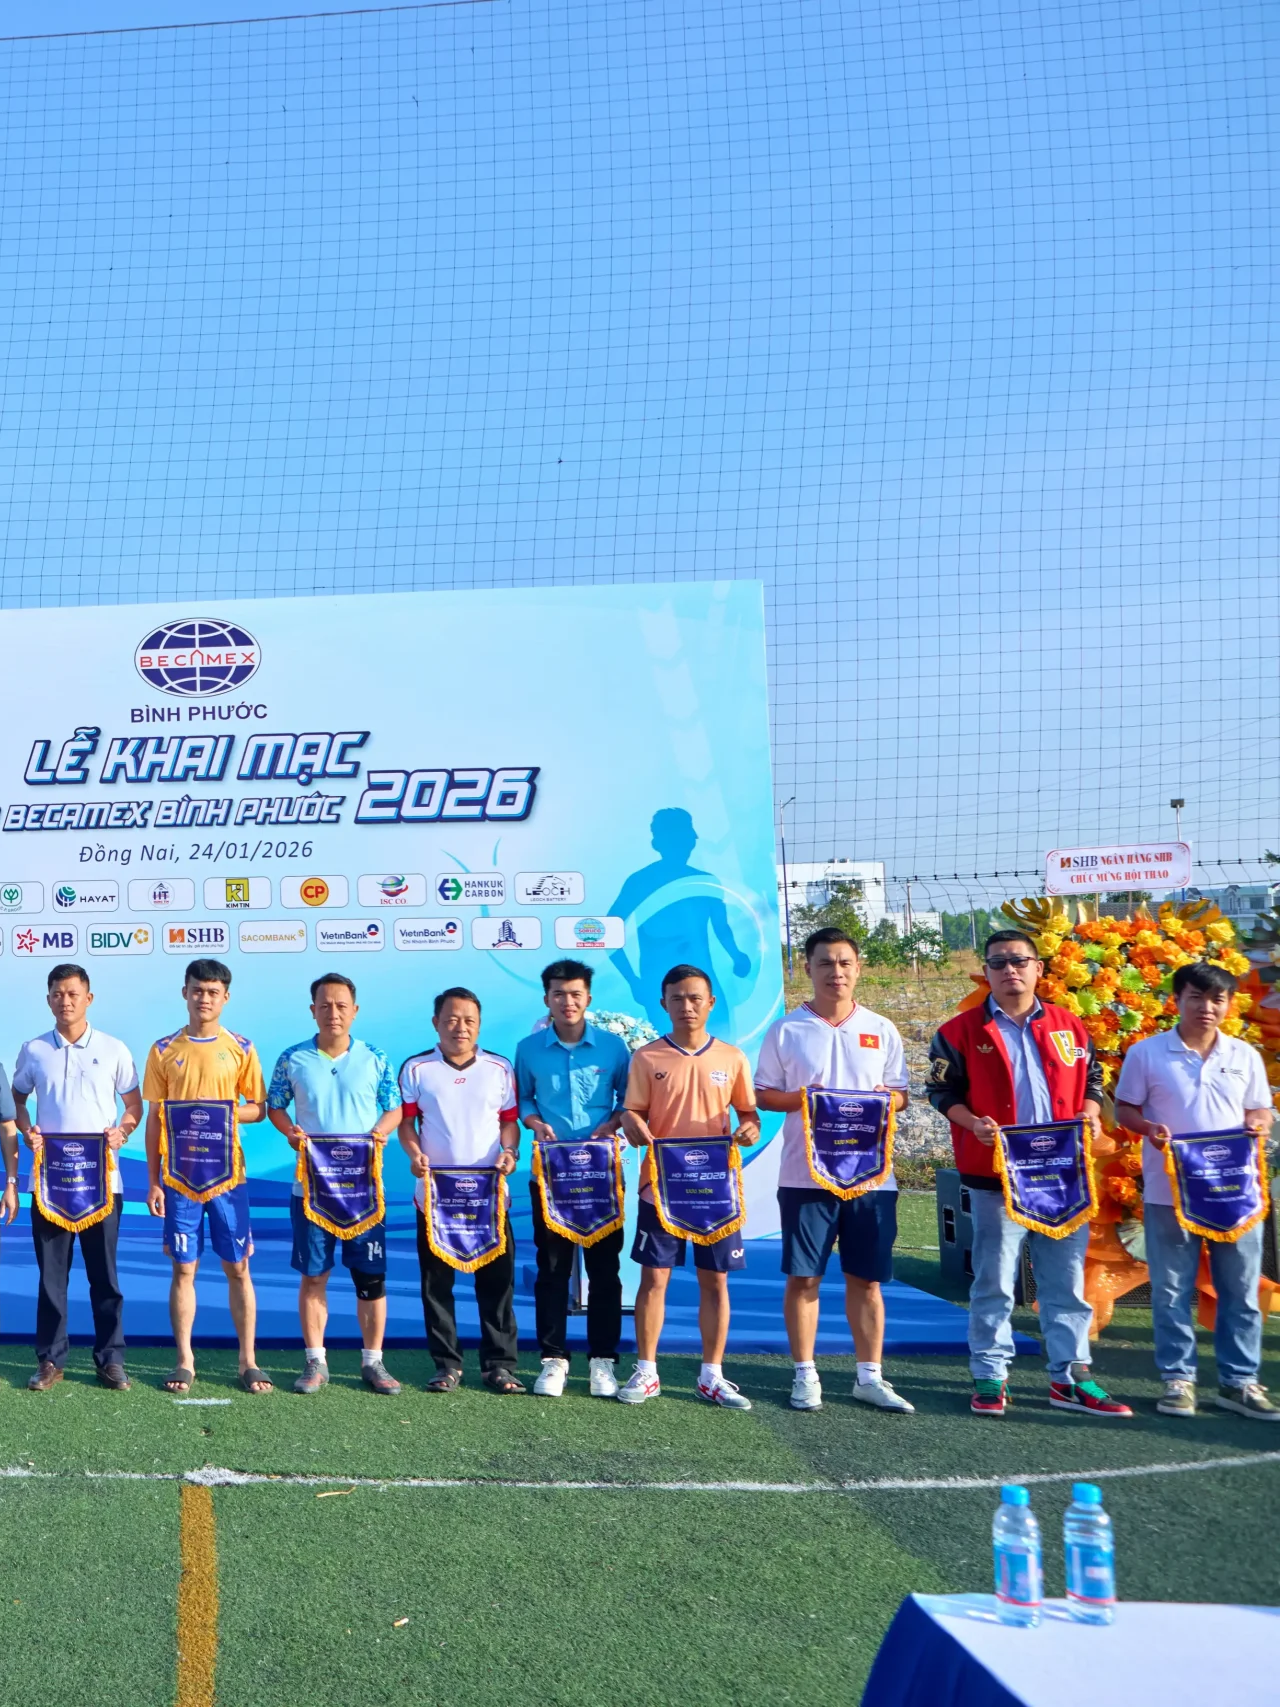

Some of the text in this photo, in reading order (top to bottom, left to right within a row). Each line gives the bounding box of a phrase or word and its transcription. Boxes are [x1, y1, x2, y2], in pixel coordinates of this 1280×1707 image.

[139, 649, 256, 668] BECAMEX
[130, 701, 268, 723] BÌNH PHƯỚC
[24, 726, 371, 786] LỄ KHAI MẠC
[3, 801, 153, 832] BECAMEX
[154, 794, 233, 827] BÌNH
[234, 791, 346, 826] PHƯỚC
[354, 765, 541, 825] 2026
[79, 840, 314, 866] Đồng Nai, 24/01/2026
[1072, 851, 1173, 867] SHB NGÂN HÀNG SHB
[464, 880, 503, 888] HANKUK
[1070, 872, 1094, 884] CHÚC
[1124, 869, 1141, 882] HỘI
[1144, 870, 1169, 880] THAO
[303, 885, 325, 898] CP
[465, 889, 503, 897] CARBON
[43, 932, 73, 948] MB
[91, 932, 134, 948] BIDV
[187, 928, 224, 943] SHB
[241, 934, 296, 942] SACOMBANK
[174, 1233, 188, 1253] 11
[638, 1229, 649, 1251] 7
[367, 1241, 383, 1261] 14
